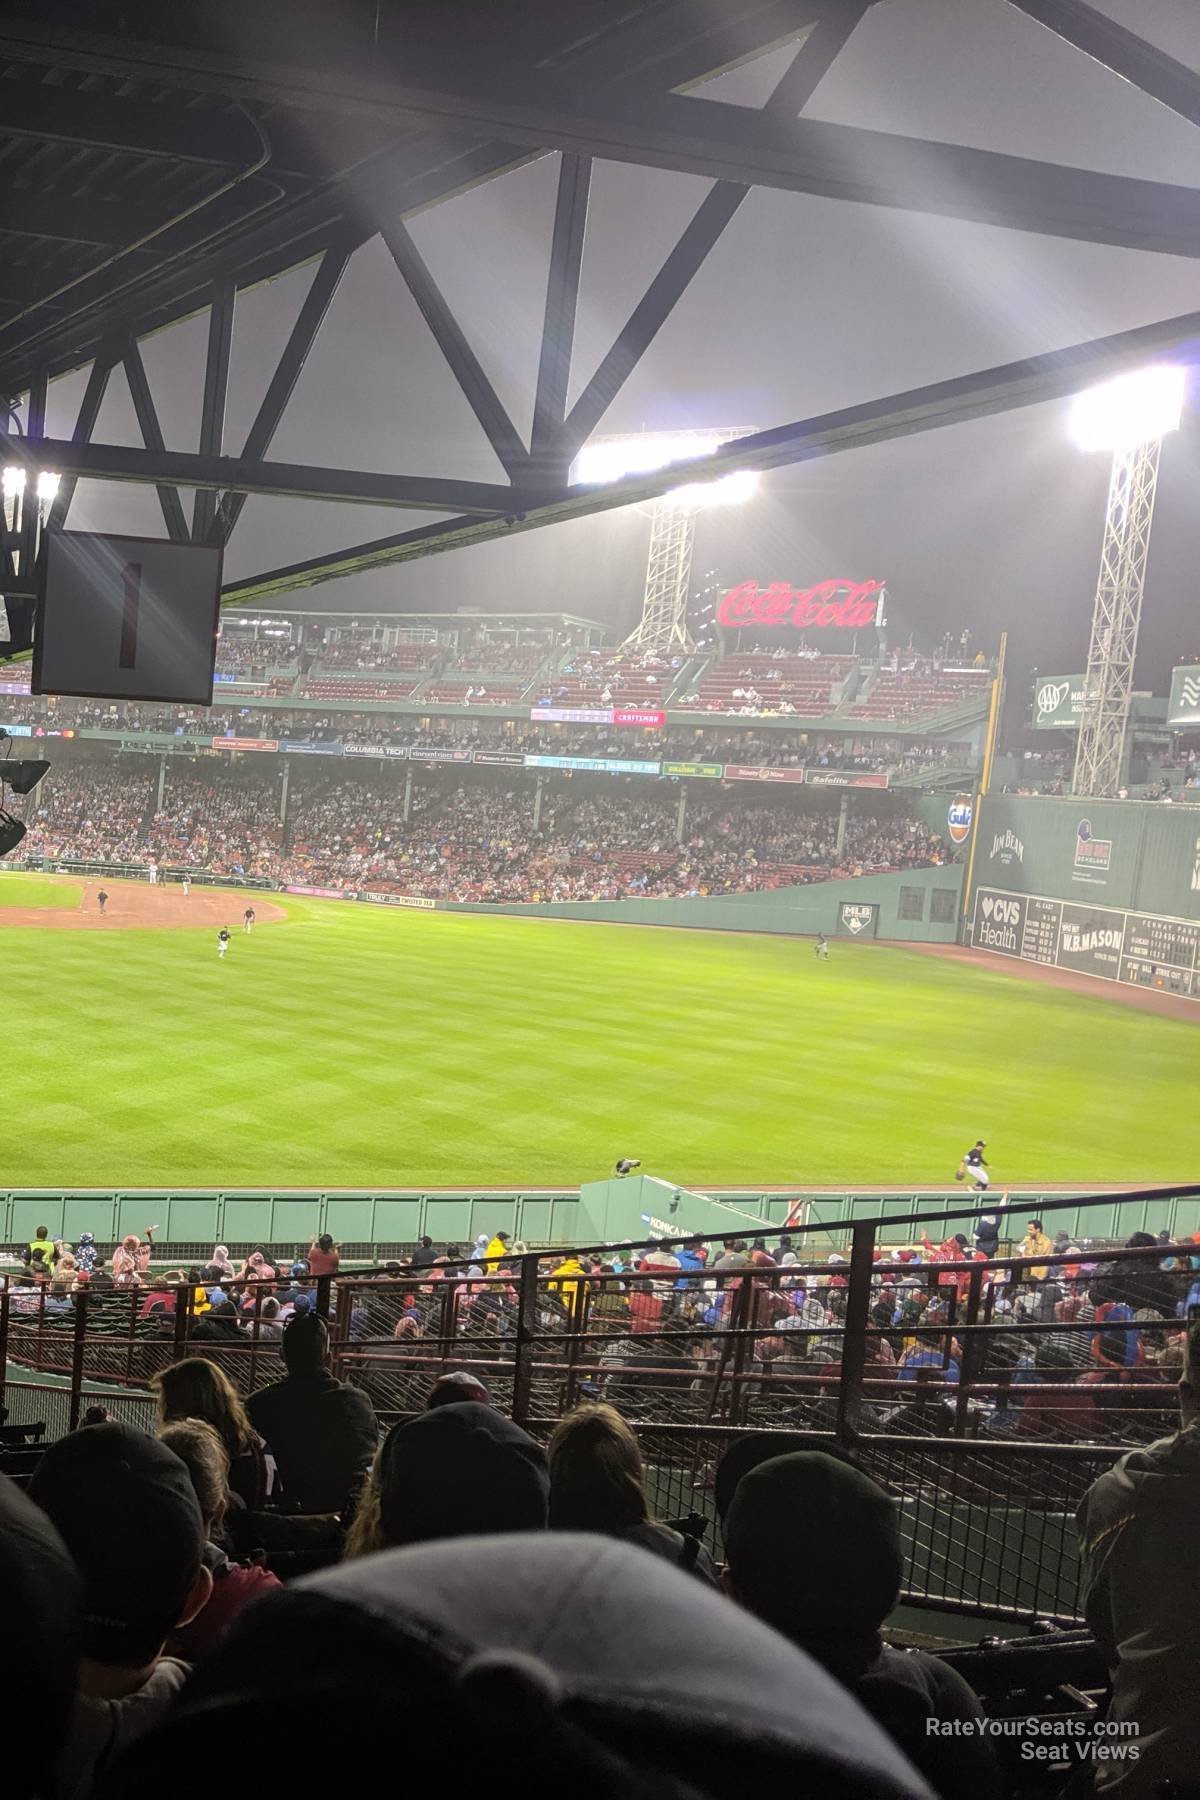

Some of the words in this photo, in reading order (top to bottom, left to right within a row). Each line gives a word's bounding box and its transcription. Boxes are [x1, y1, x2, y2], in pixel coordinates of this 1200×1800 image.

[345, 744, 384, 754] COLUMBIA
[386, 747, 404, 756] TECH
[812, 776, 848, 784] Safelite
[1005, 829, 1024, 863] BEAM
[994, 899, 1020, 925] CVS
[979, 921, 1016, 950] Health
[650, 1216, 680, 1237] KONICA
